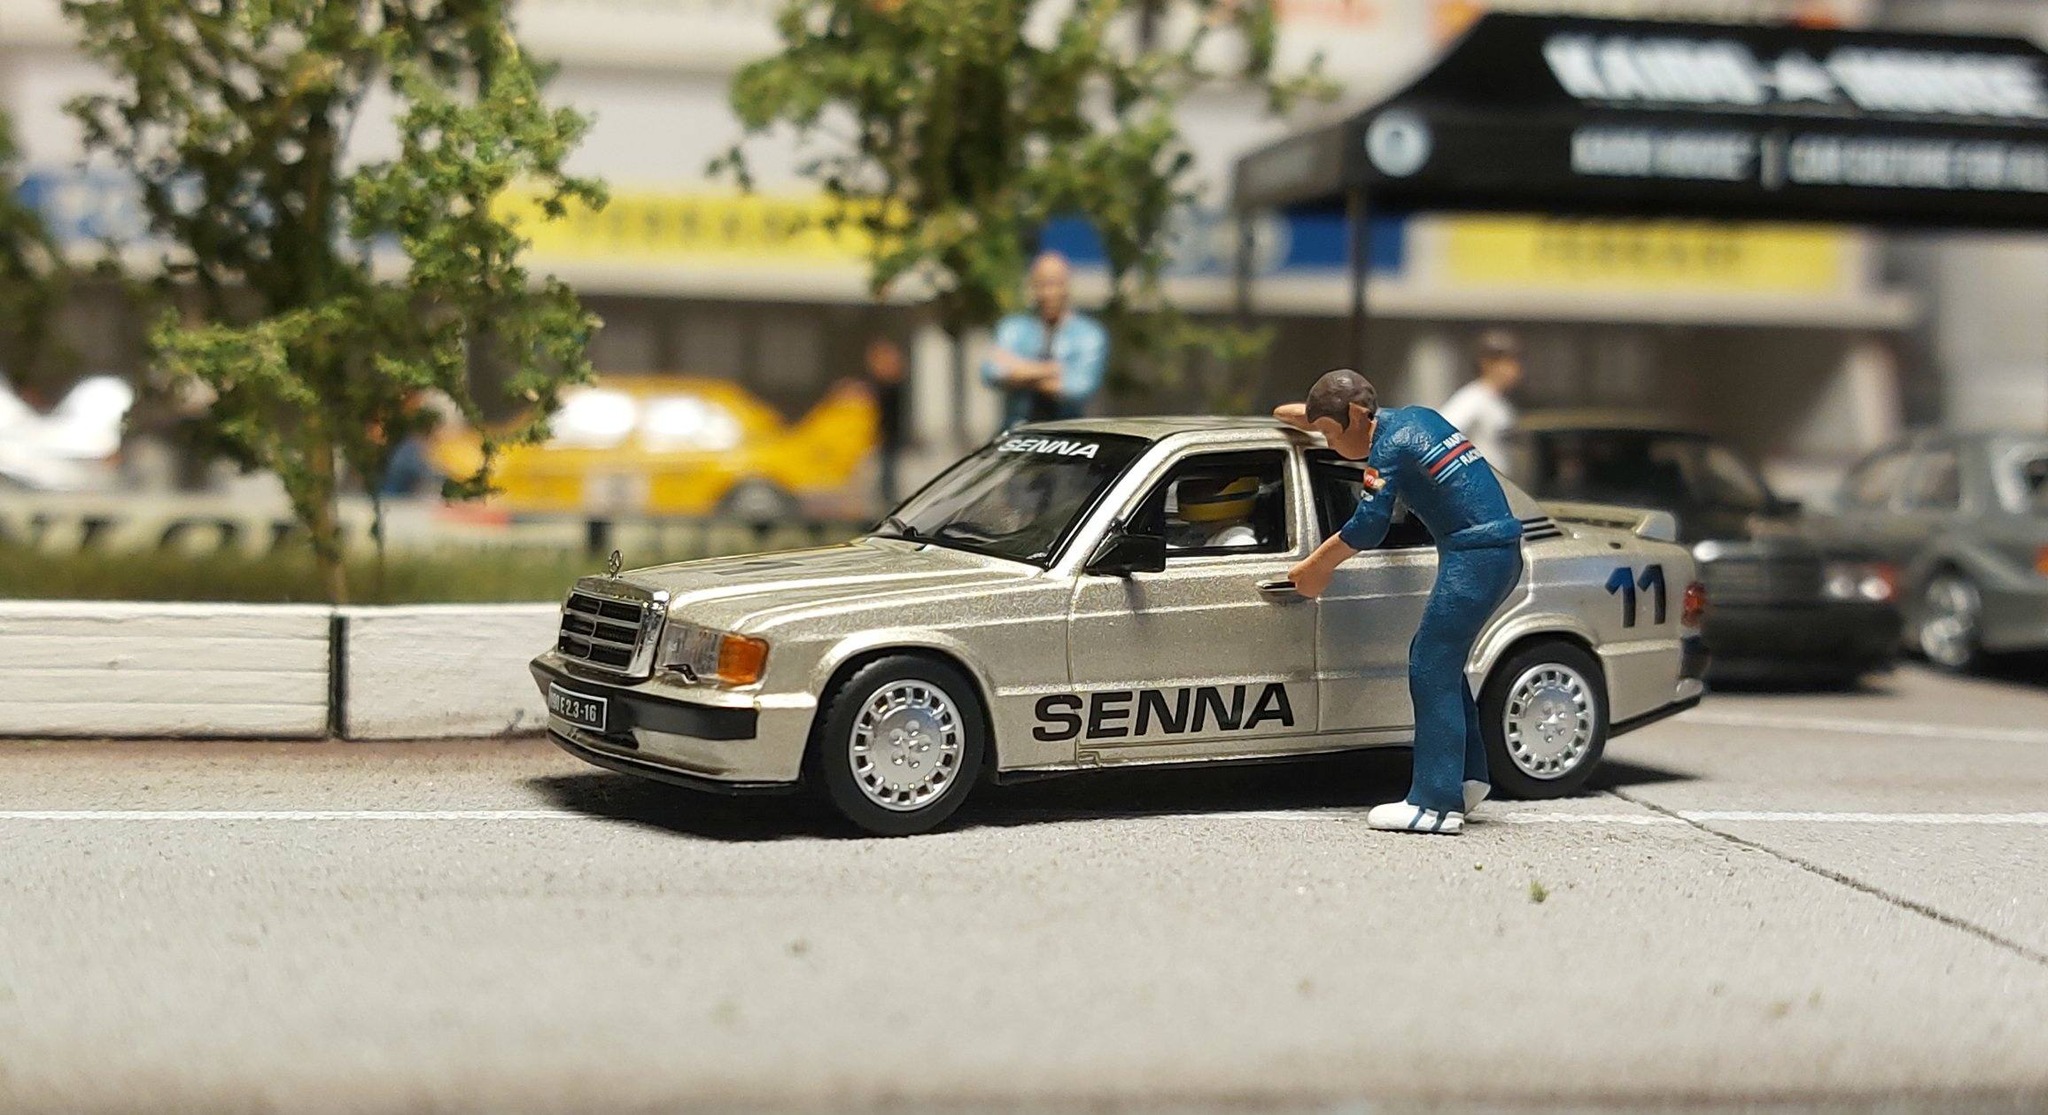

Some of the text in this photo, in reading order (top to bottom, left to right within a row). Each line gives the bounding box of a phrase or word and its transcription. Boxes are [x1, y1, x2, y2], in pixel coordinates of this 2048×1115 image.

[998, 438, 1100, 459] SENNA
[1604, 563, 1667, 629] 11
[1032, 682, 1295, 742] SENNA
